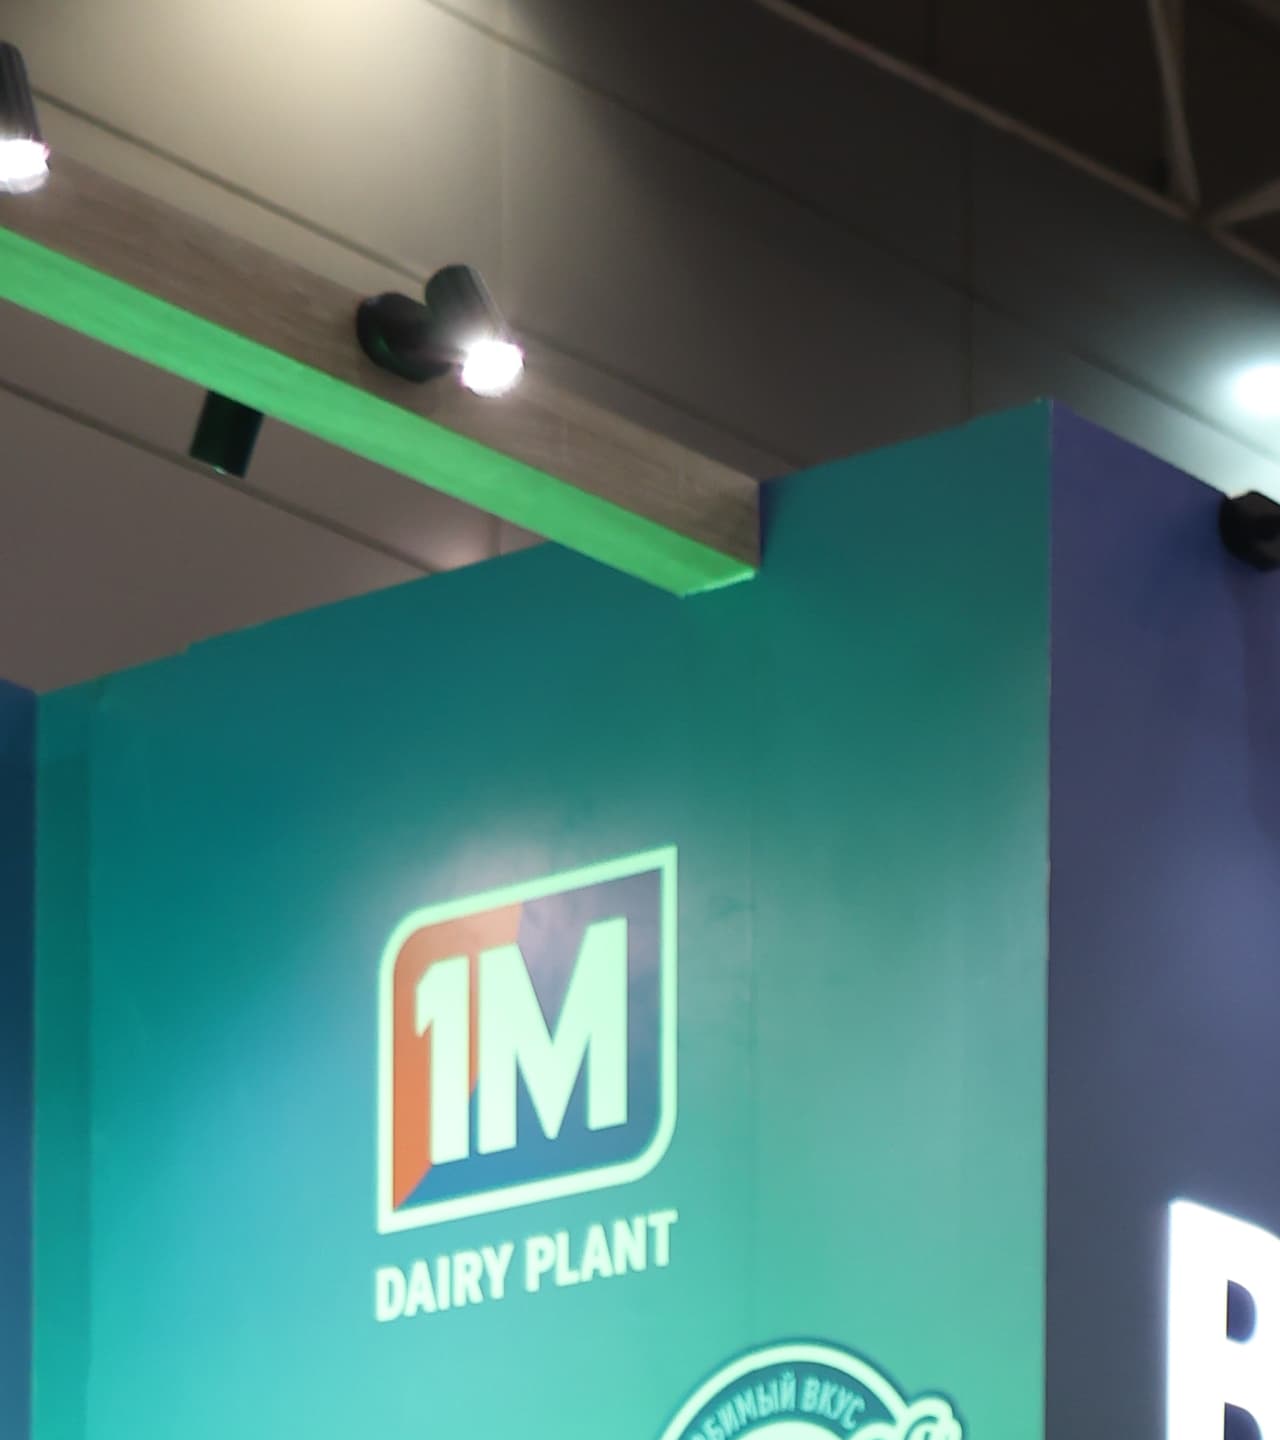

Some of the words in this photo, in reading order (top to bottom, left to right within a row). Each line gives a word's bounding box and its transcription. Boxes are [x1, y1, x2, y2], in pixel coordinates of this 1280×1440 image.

[415, 916, 628, 1165] 1M
[375, 1243, 514, 1322] DAIRY
[524, 1209, 678, 1292] PLANT
[802, 1376, 866, 1430] ВКУС
